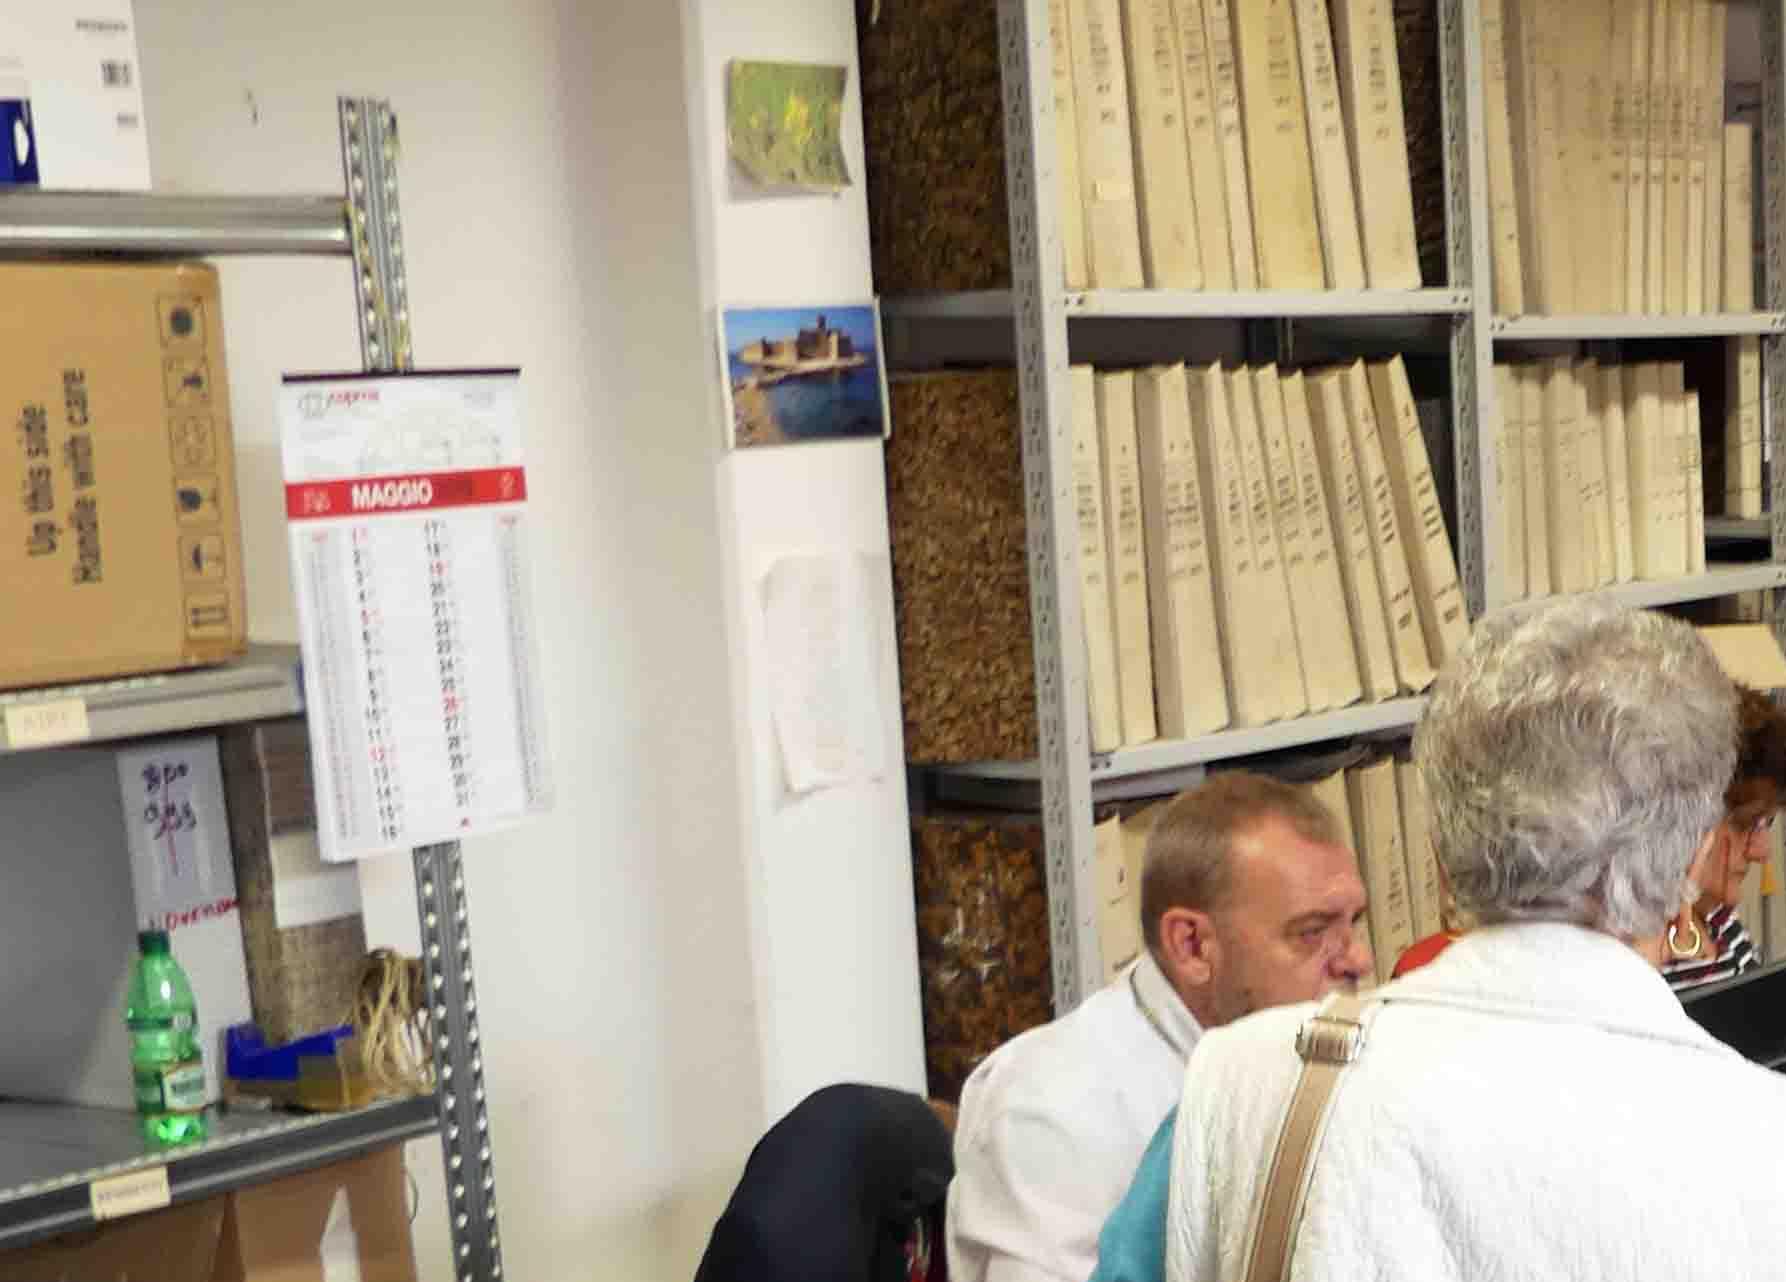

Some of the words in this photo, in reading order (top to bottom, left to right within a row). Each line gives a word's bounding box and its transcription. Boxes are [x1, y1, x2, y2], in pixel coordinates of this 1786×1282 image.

[63, 368, 88, 427] care
[20, 404, 49, 458] side
[66, 433, 96, 490] with
[24, 464, 54, 514] this
[351, 479, 433, 510] MAGGIO
[26, 520, 61, 558] Up
[68, 494, 103, 586] Handle
